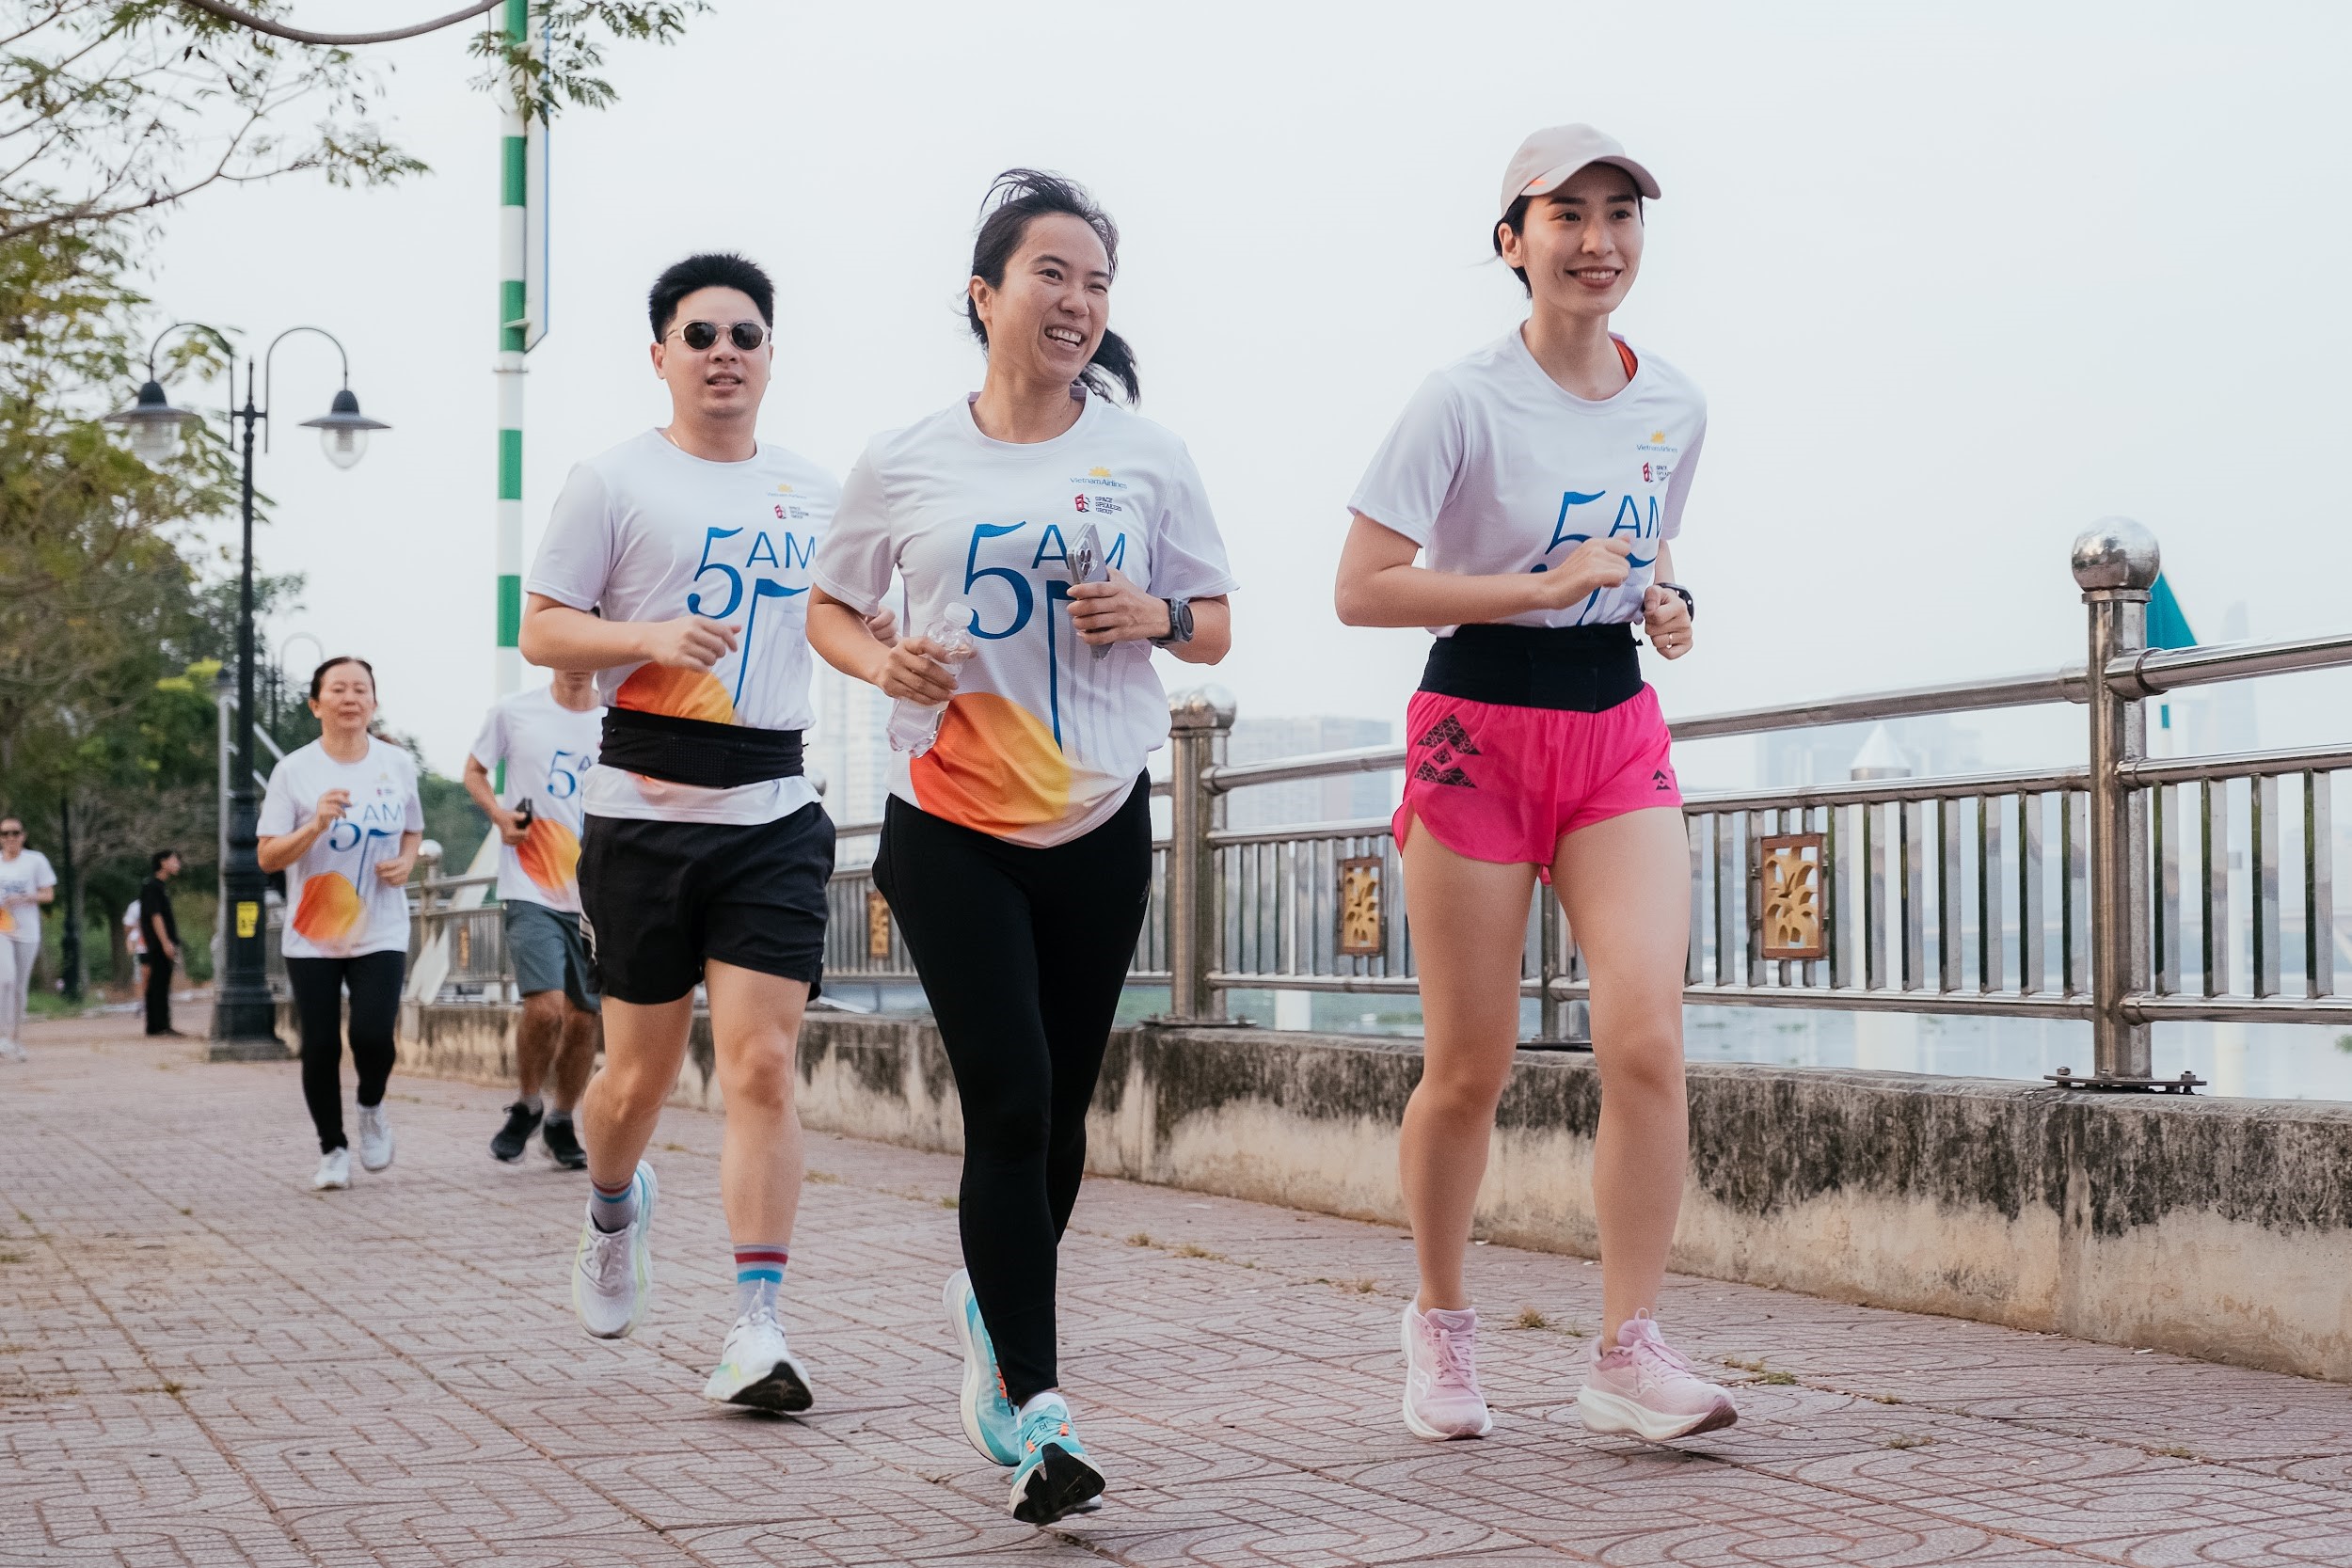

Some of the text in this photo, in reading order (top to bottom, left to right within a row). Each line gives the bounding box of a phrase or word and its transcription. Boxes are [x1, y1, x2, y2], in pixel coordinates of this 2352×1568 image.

[688, 527, 815, 619] 5 AM
[964, 521, 1033, 639] 5
[548, 751, 576, 799] 5
[363, 803, 404, 822] AM
